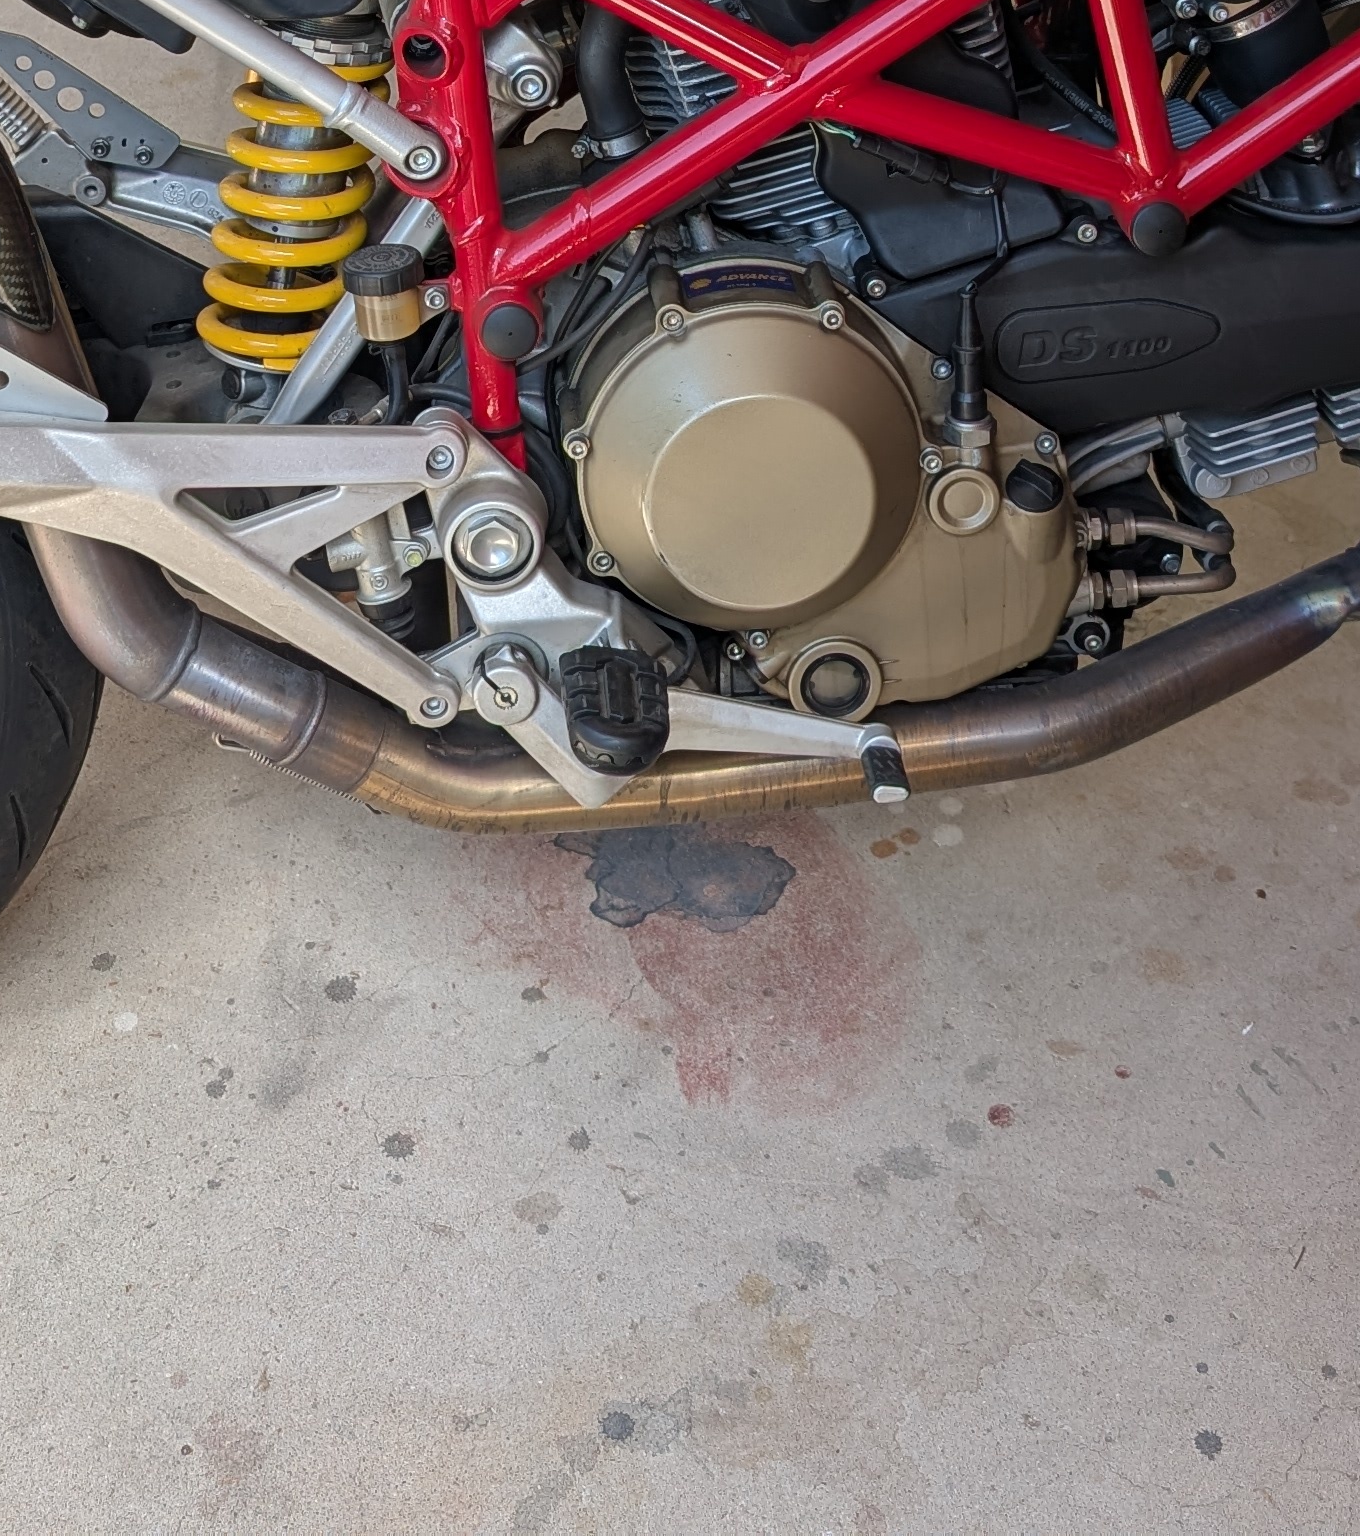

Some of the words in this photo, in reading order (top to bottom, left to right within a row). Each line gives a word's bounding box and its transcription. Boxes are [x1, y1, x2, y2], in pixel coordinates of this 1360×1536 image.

[716, 272, 788, 283] ADVANCE
[1018, 324, 1099, 370] DS
[1105, 335, 1173, 360] 1100
